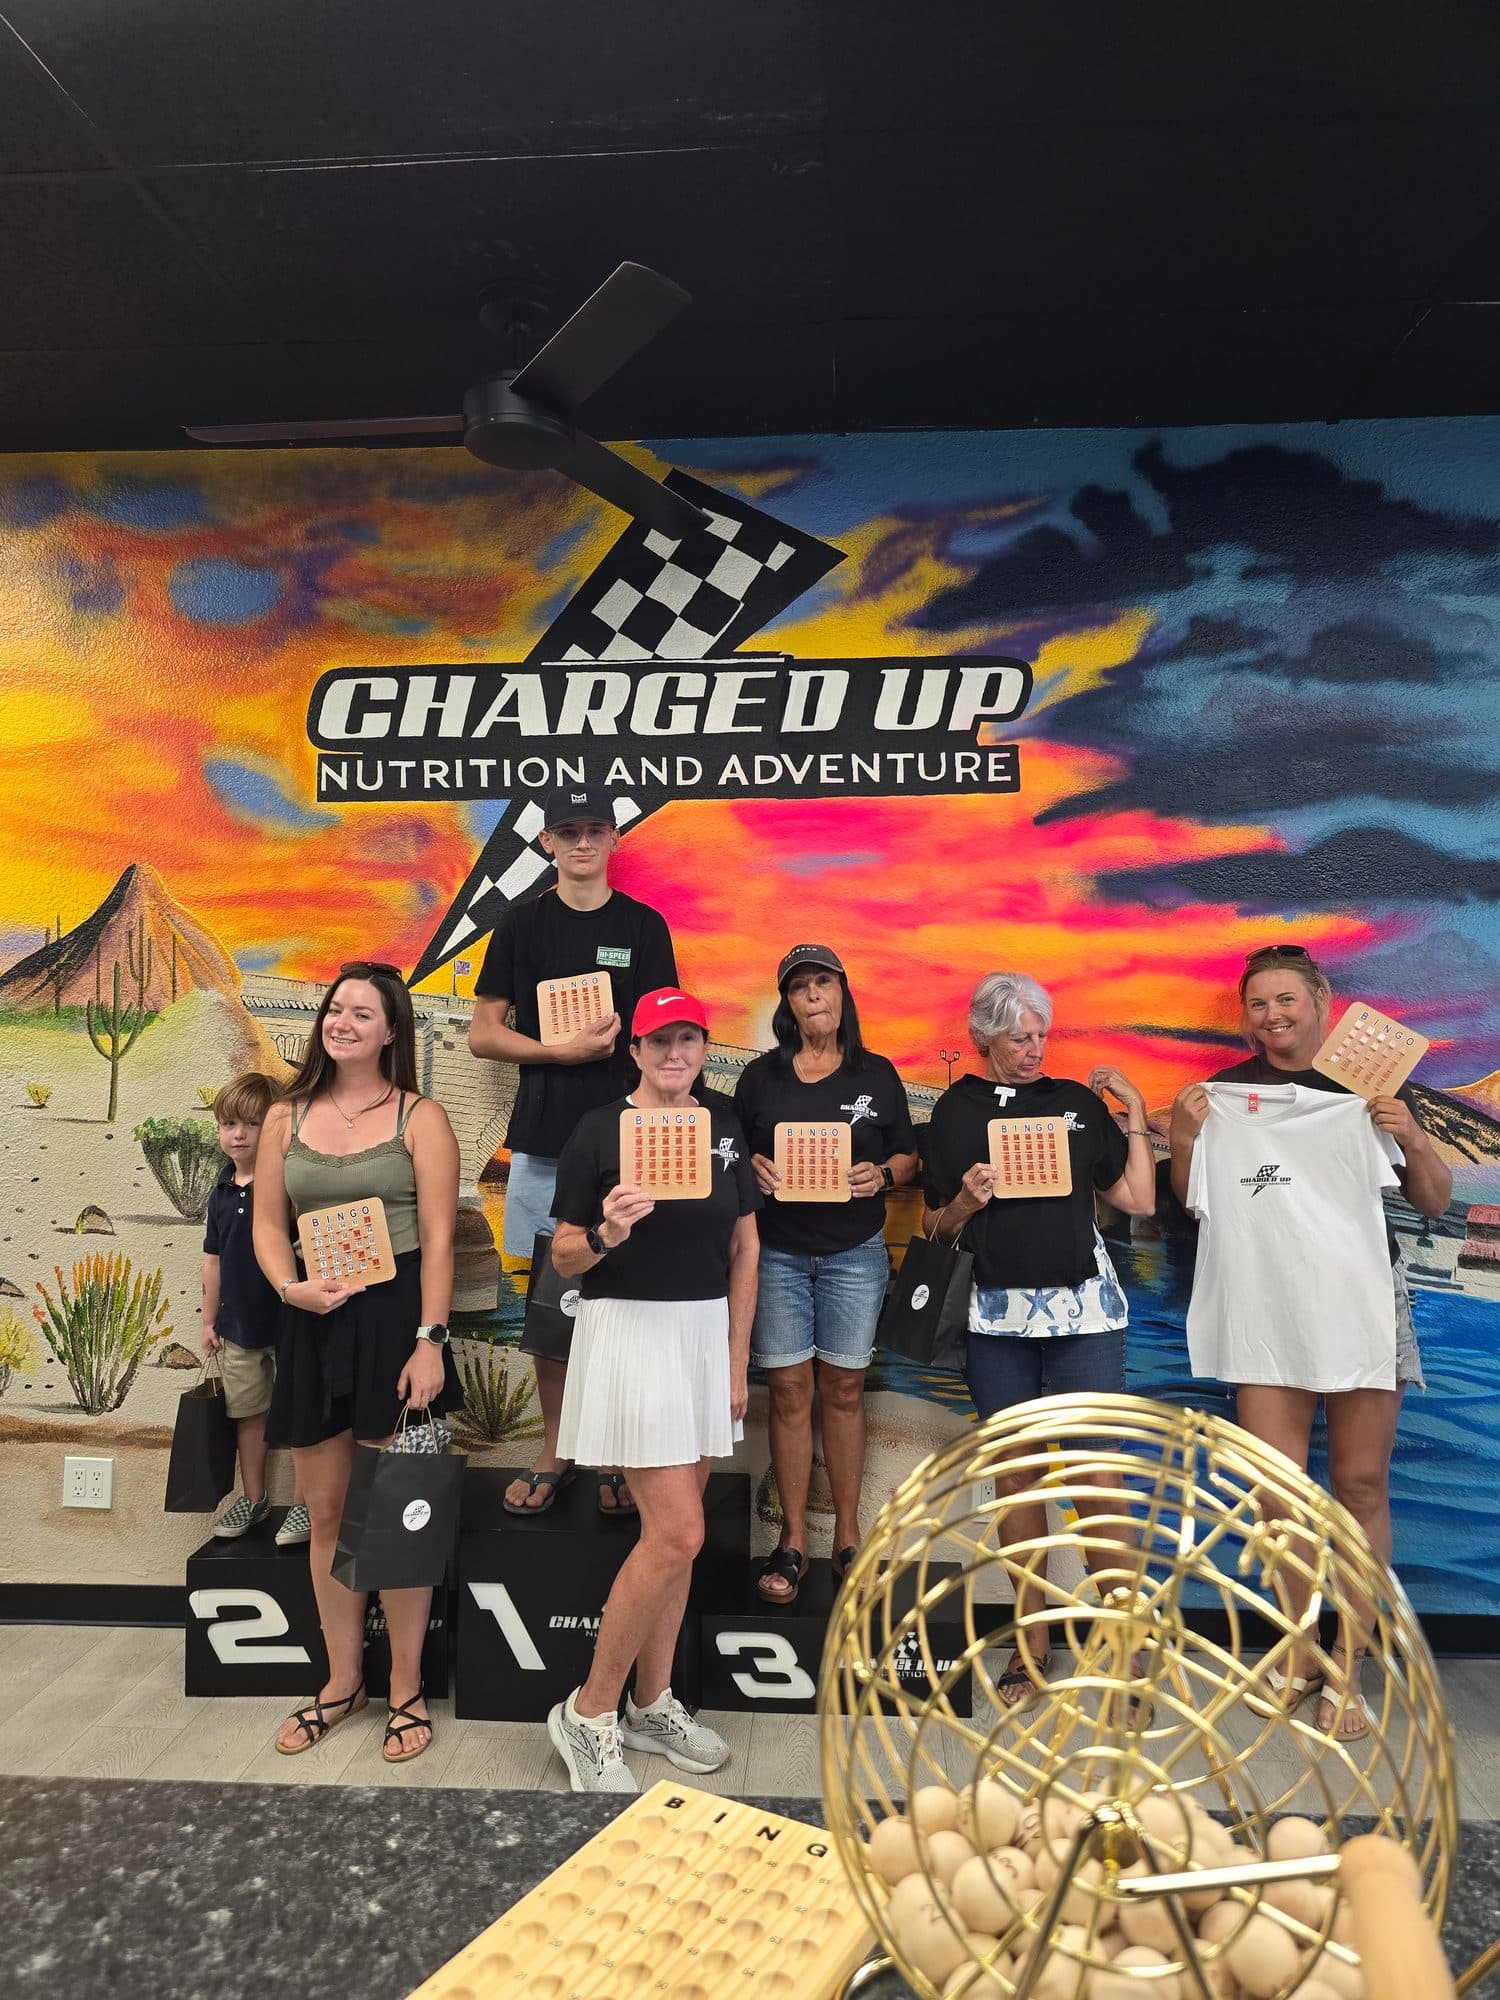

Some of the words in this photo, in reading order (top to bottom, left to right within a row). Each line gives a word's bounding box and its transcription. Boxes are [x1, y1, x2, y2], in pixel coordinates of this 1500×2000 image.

[317, 667, 850, 739] CHARGED
[870, 665, 1027, 733] UP
[320, 755, 585, 792] NUTRITION
[603, 755, 703, 786] AND
[717, 752, 1013, 788] ADVENTURE
[549, 977, 599, 991] BINGO
[1360, 1011, 1415, 1046] BINGO
[635, 1114, 696, 1124] BINGO
[787, 1128, 839, 1136] BINGO
[1001, 1123, 1054, 1133] BINGO
[311, 1205, 369, 1227] BINGO
[188, 1588, 312, 1664] 2
[468, 1582, 547, 1670] 1
[715, 1631, 816, 1699] 3
